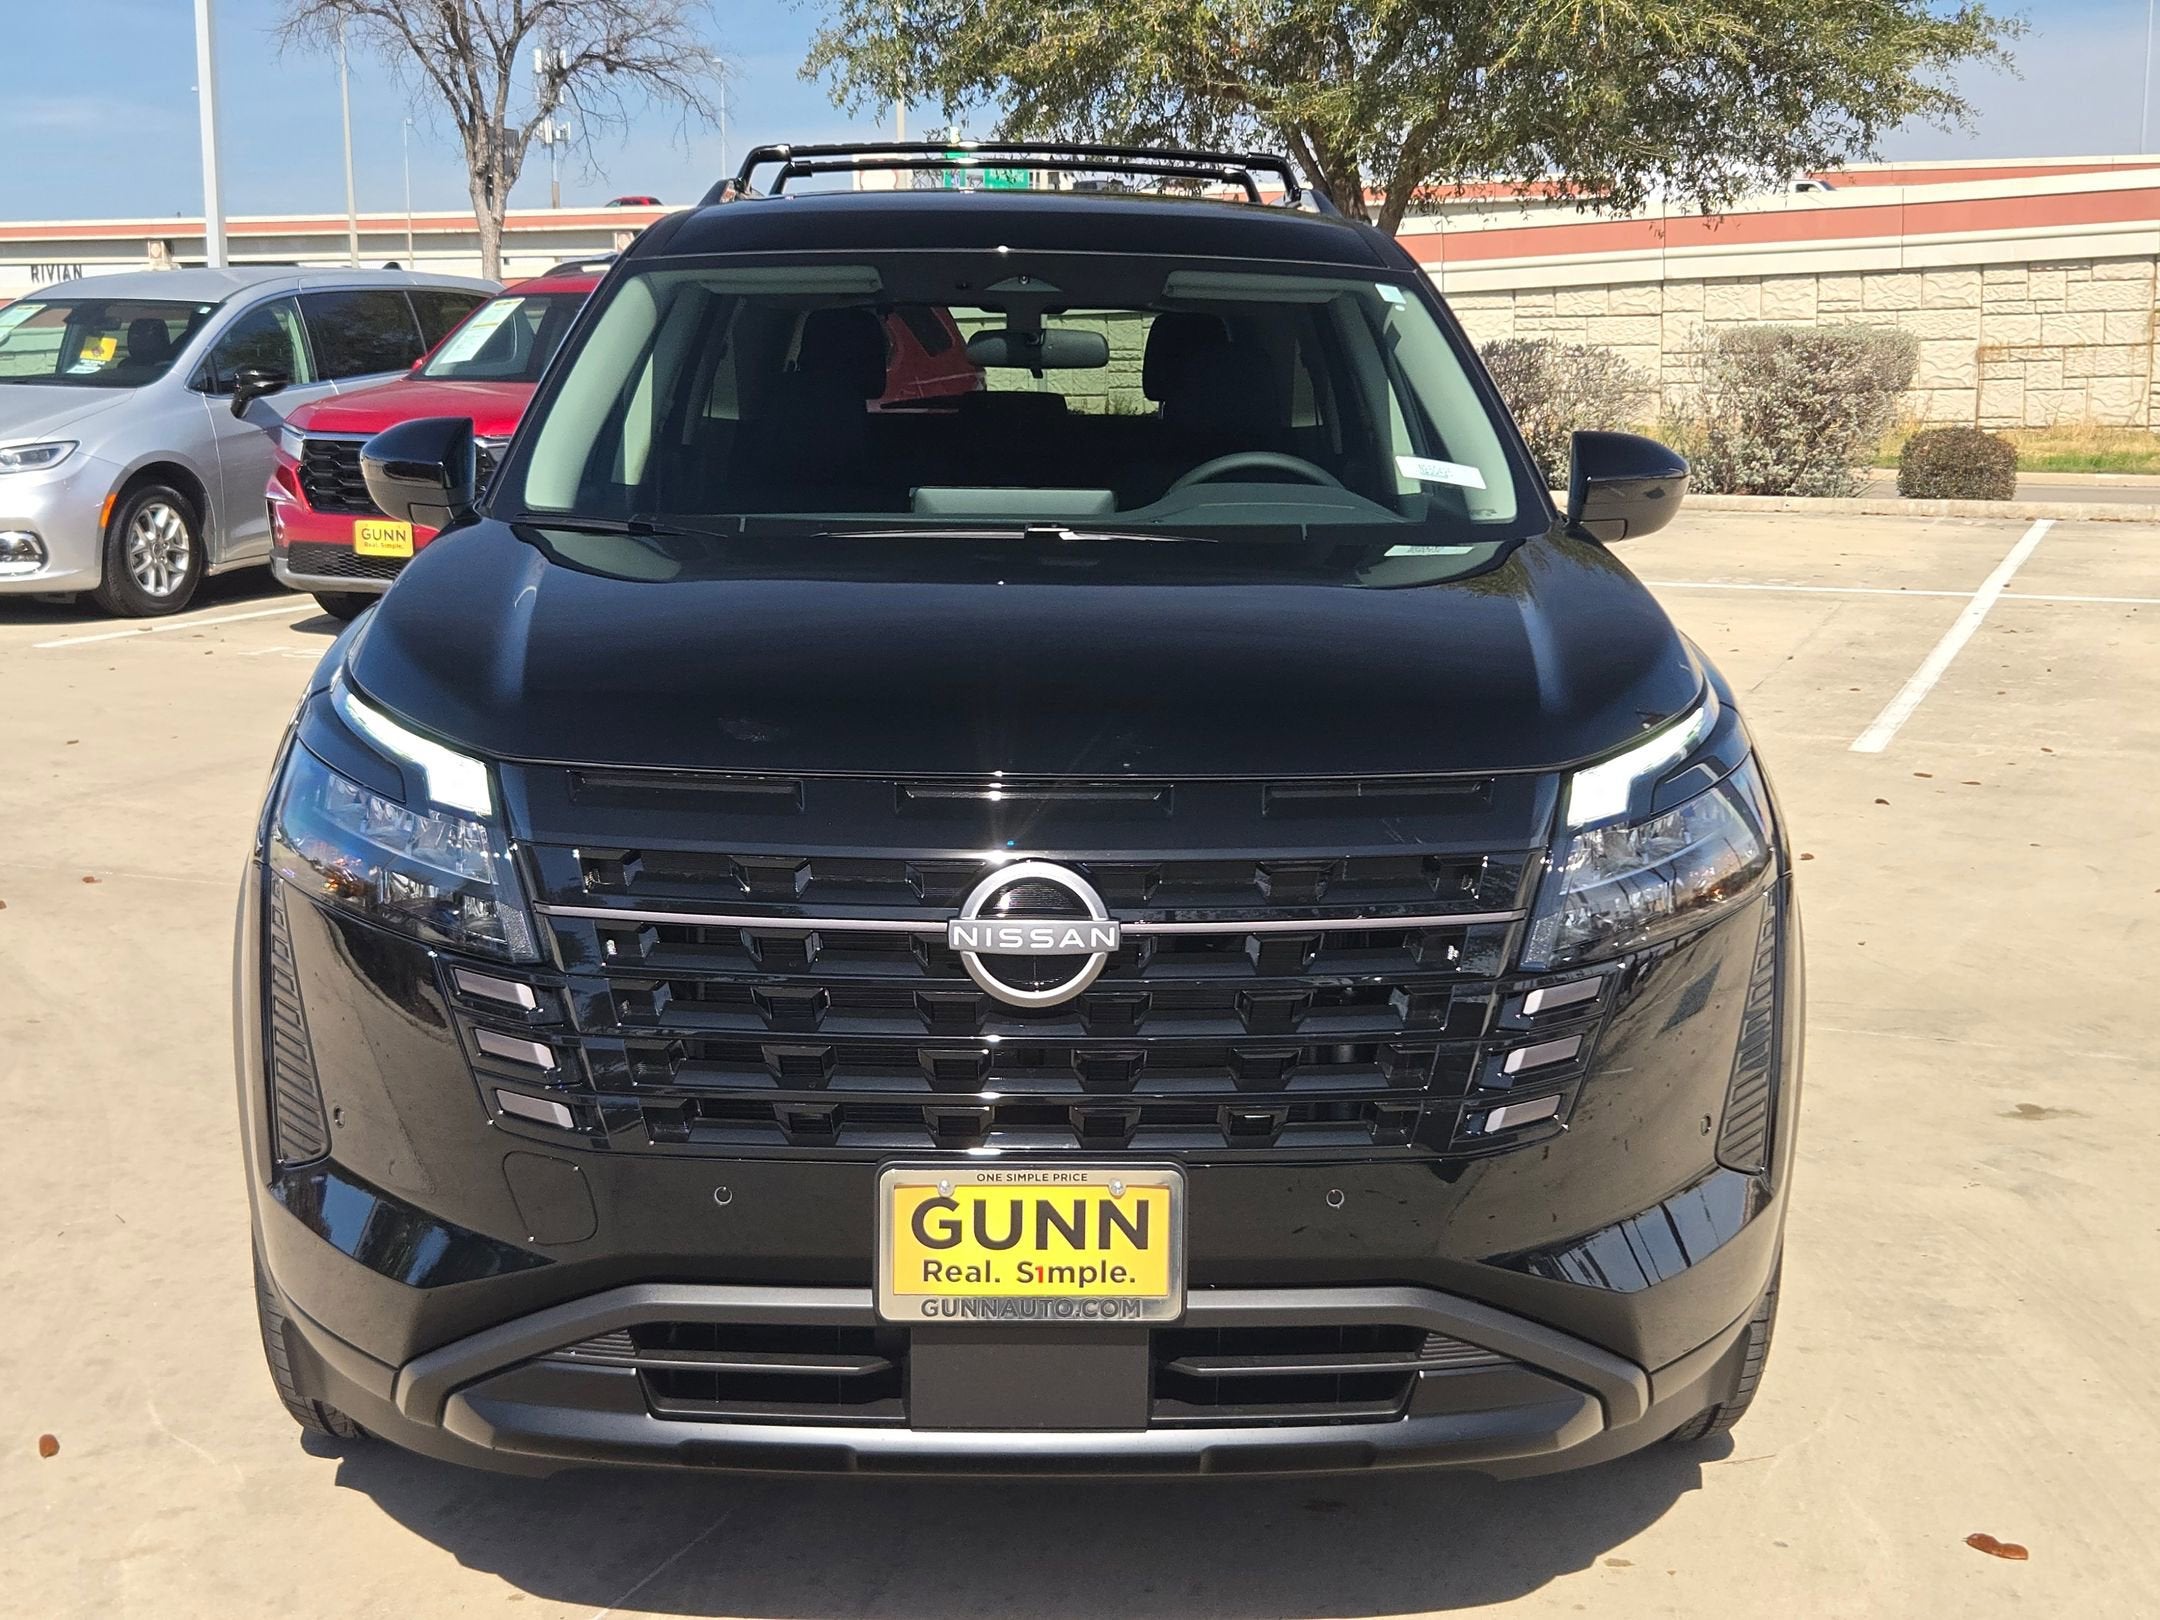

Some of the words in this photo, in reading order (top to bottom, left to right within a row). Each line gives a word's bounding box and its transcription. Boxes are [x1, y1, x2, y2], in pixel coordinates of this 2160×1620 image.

[30, 264, 83, 283] RIVIAN
[361, 527, 406, 542] GUNN
[953, 926, 1115, 949] NISSAN
[976, 1173, 1002, 1182] ONE
[1006, 1173, 1049, 1182] SIMPLE
[1053, 1173, 1088, 1182] PRICE
[911, 1197, 1149, 1250] GUNN
[923, 1259, 1001, 1284] Real.
[920, 1299, 1141, 1319] GUNNAUTO.COM
